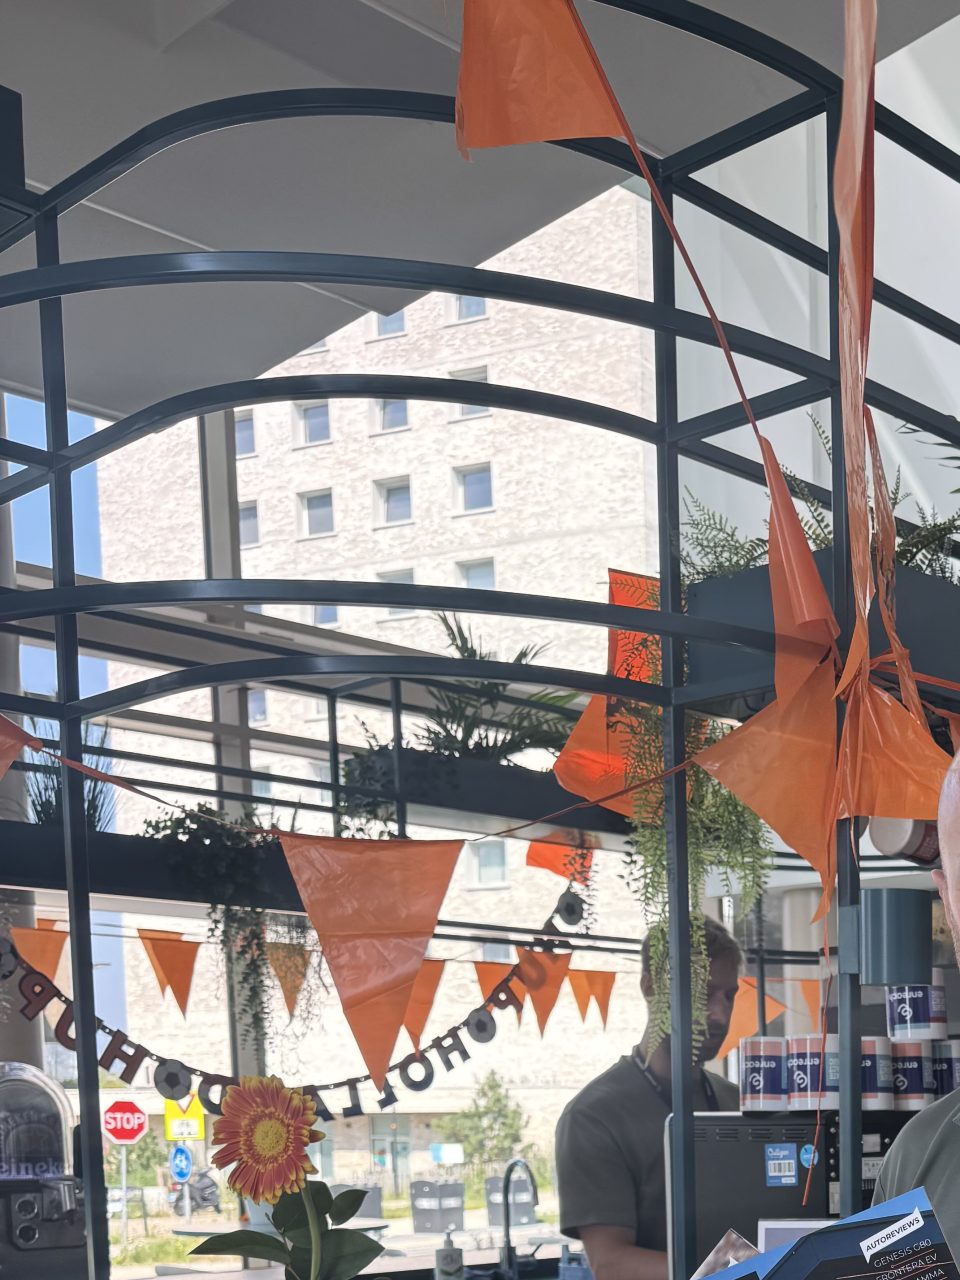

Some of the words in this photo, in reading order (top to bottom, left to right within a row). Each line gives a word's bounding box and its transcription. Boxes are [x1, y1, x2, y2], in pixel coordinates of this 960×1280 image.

[104, 1111, 146, 1131] STOP
[865, 1216, 920, 1253] AUTOREVIEWS
[873, 1246, 913, 1268] GENESIS
[913, 1238, 932, 1251] G80
[925, 1253, 937, 1264] EV
